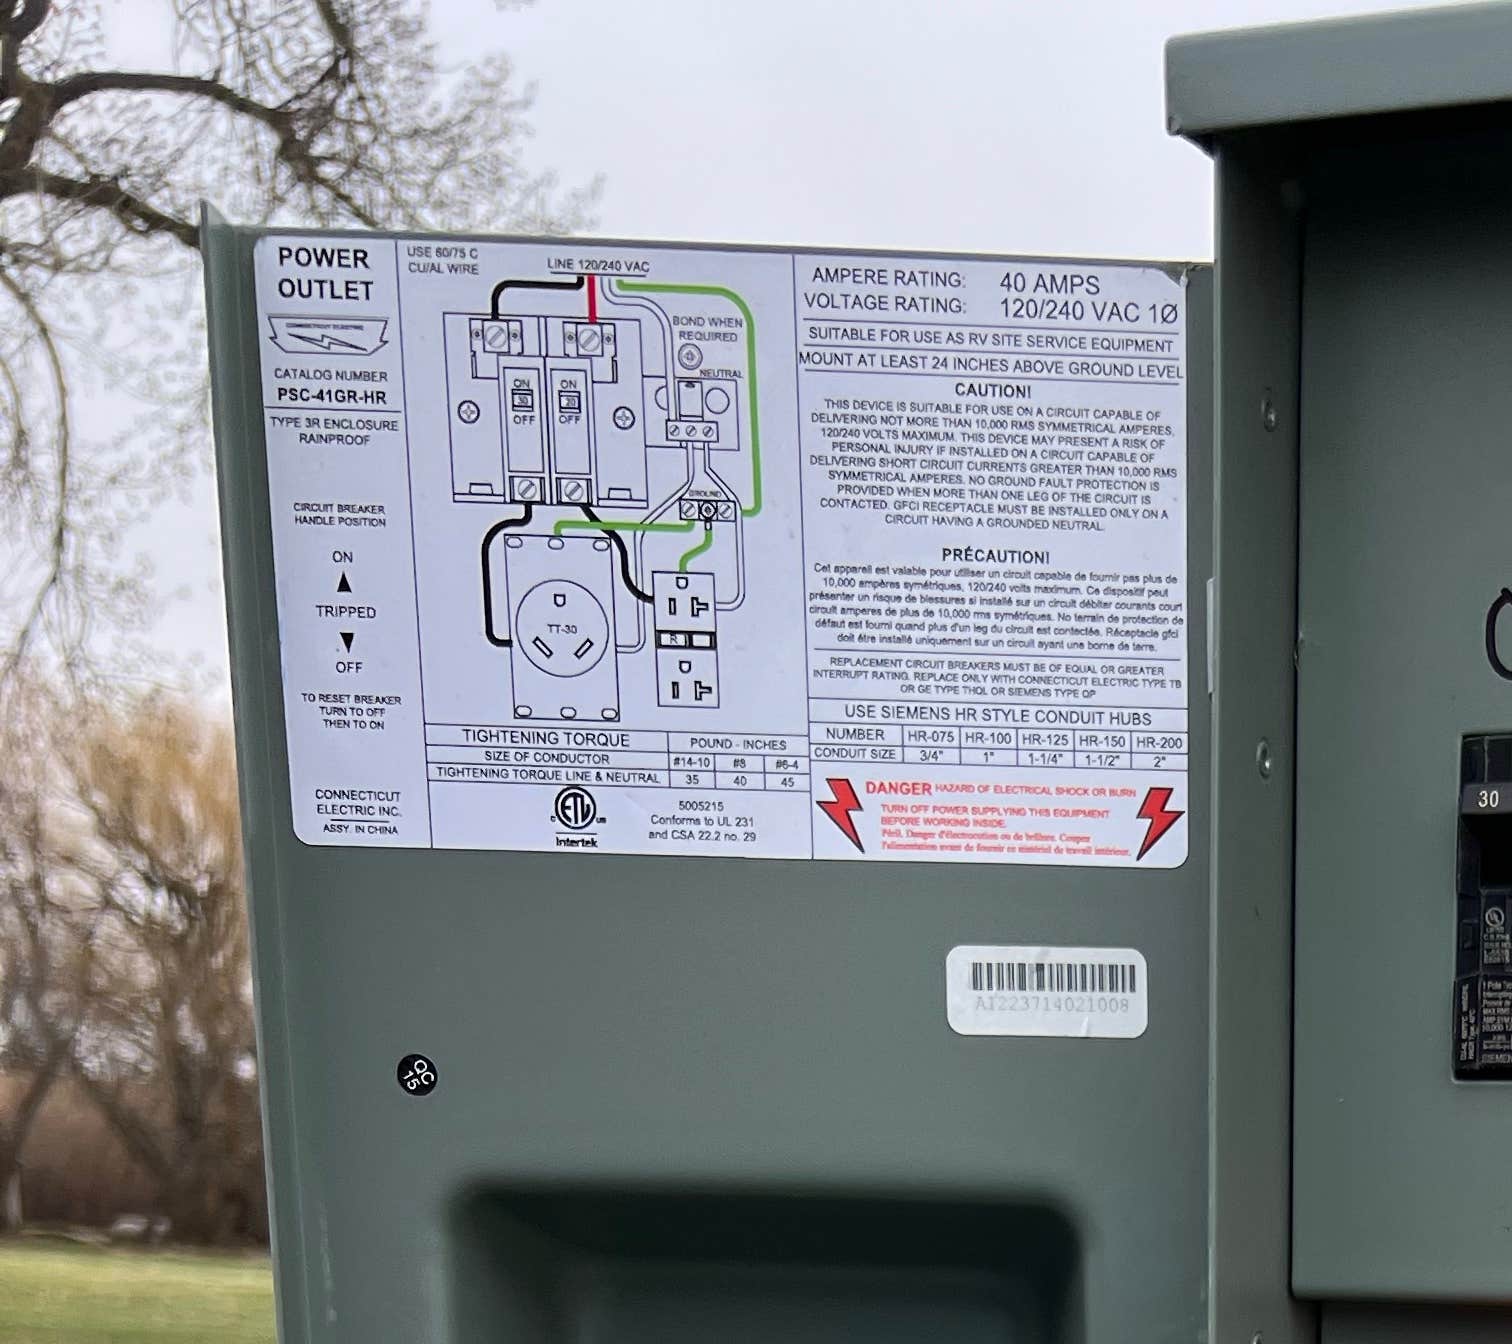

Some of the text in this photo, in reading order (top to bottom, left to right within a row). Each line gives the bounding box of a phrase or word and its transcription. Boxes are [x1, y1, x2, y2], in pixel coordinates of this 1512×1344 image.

[279, 246, 369, 268] POWER
[408, 261, 478, 275] CU/AL WIRE
[547, 257, 649, 275] LINE 120/240 VAC
[812, 266, 965, 287] AMPERE RATING:
[1000, 271, 1099, 295] 40 AMPS
[278, 278, 373, 300] OUTLET
[804, 292, 966, 313] VOLTAGE RATING:
[1001, 297, 1084, 320] 120/240
[1091, 301, 1139, 322] VAC
[672, 315, 745, 327] BOND WHEN
[678, 330, 737, 342] REQUIRED
[809, 326, 1173, 352] SUITABLE FOR USE AS RV SITE SERVICE EQUIPMENT
[797, 351, 1183, 378] MOUNT AT LEAST 24 INCHES ABOVE GROUND LEVEL
[274, 367, 387, 382] CATALOG NUMBER
[698, 368, 743, 379] NEUTRAL
[278, 387, 386, 404] PSC-41GR-HR
[955, 382, 1030, 398] CAUTION!
[269, 416, 398, 431] TYPE 3R ENCLOSURE
[299, 433, 369, 445] RAINPROOF
[293, 502, 385, 514] CIRCUIT BREAKER
[294, 515, 386, 527] HANDLE POSITION
[332, 550, 352, 563] ON
[942, 545, 1049, 564] PRÉCAUTION!
[315, 605, 376, 618] TRIPPED
[547, 623, 577, 634] TT-30
[335, 661, 362, 673] OFF
[301, 693, 401, 705] TO RESET BREAKER
[319, 706, 385, 716] TURN TO OFF
[845, 704, 1151, 726] USE SIEMENS HR STYLE CONDUIT HUBS
[323, 718, 384, 729] THEN TO ON
[462, 728, 629, 747] TIGHTENING TORQUE
[690, 737, 786, 750] POUND INCHES
[826, 727, 1182, 748] NUMBER HR-075 HR-100 HR-125 HR-150 HR-200
[485, 750, 609, 764] SIZE OF CONDUCTOR
[814, 747, 1166, 769] CONDUIT SIZE 3/4" 1" 1-1/4" 1-1/2" 2"
[436, 766, 660, 783] TIGHTENING TORQUE LINE & NEUTRAL
[685, 774, 796, 788] 35 40 45
[315, 788, 400, 801] CONNECTICUT
[866, 781, 931, 795] DANGER
[679, 800, 724, 811] 5005215
[1478, 790, 1500, 808] 30
[317, 804, 403, 816] ELECTRIC INC.
[650, 814, 753, 827] Conforms to UL 231
[556, 837, 598, 848] Intertek
[414, 1060, 434, 1084] QC
[403, 1070, 420, 1090] 15
